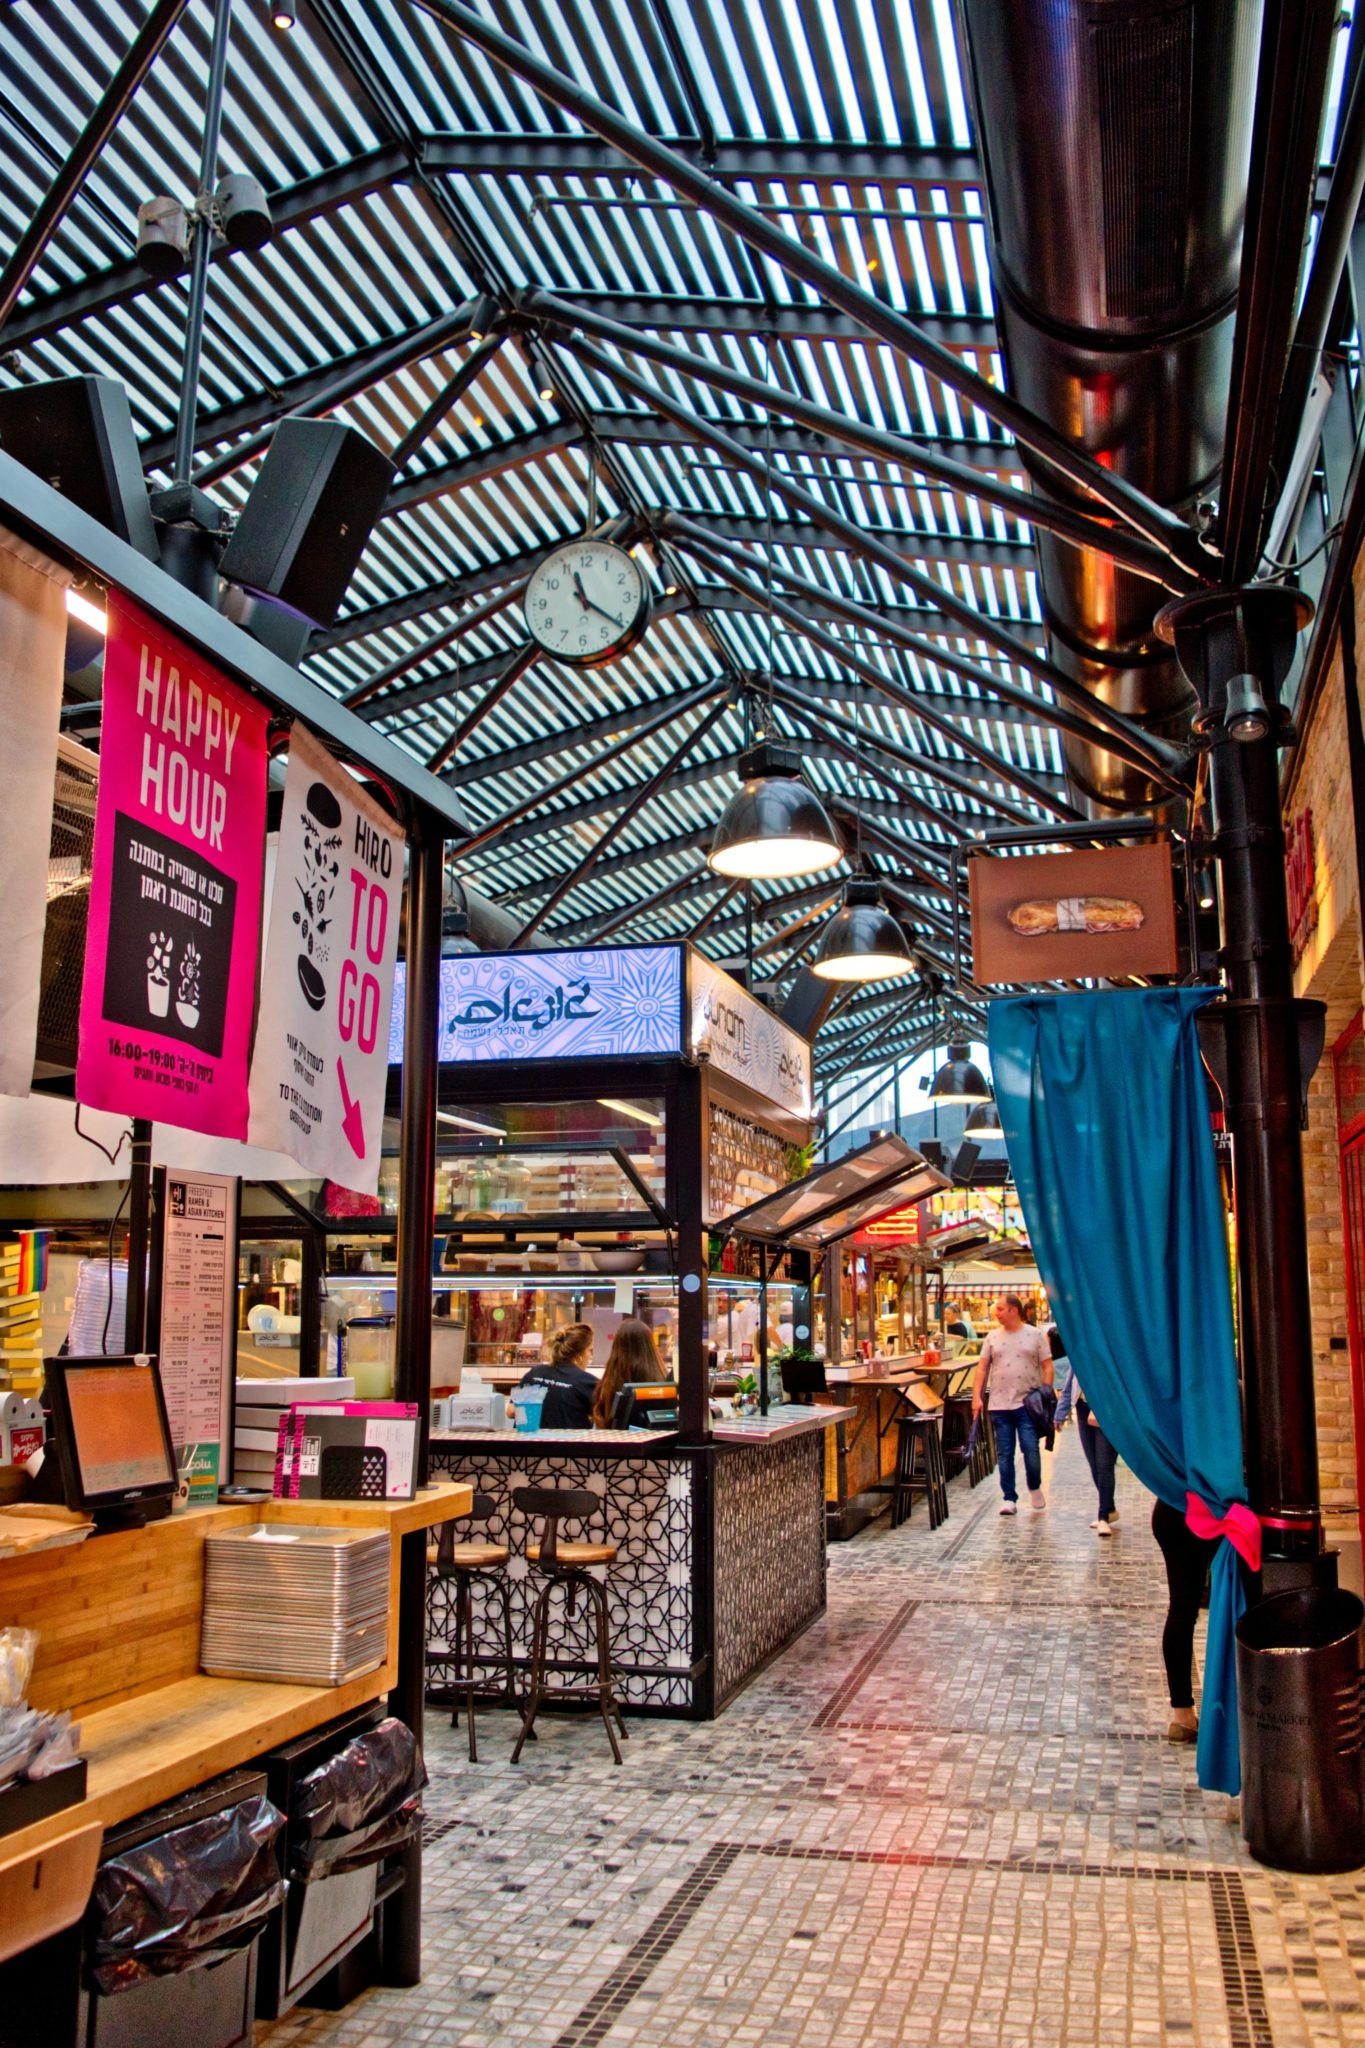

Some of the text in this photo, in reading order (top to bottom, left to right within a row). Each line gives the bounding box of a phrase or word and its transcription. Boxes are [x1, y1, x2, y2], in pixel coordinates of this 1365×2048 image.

[580, 555, 593, 568] 12
[604, 560, 609, 572] 1
[562, 564, 571, 575] 11
[546, 579, 559, 590] 10
[618, 573, 625, 585] 2
[623, 592, 631, 603] 3
[539, 598, 547, 610] 9
[544, 617, 553, 629] 8
[560, 630, 568, 642] 7
[600, 627, 609, 639] 5
[579, 635, 587, 646] 6
[136, 643, 241, 776] HAPPY
[140, 731, 226, 852] HOUR
[354, 814, 392, 880] HIRO
[129, 840, 224, 904] סלט או שתייה במתנה
[141, 874, 212, 927] בכל הזמנת ראמן
[350, 868, 390, 967] TO
[338, 958, 381, 1054] GO
[463, 1025, 525, 1038] תאכל נשמה
[108, 1038, 176, 1070] 16:00-19:00
[280, 1083, 290, 1100] TO
[188, 1186, 213, 1198] FREESTYLE
[188, 1197, 205, 1207] RAMEN
[188, 1208, 224, 1219] ASIAN KITCHEN
[277, 1414, 289, 1448] MENU
[293, 1414, 306, 1448] MENU
